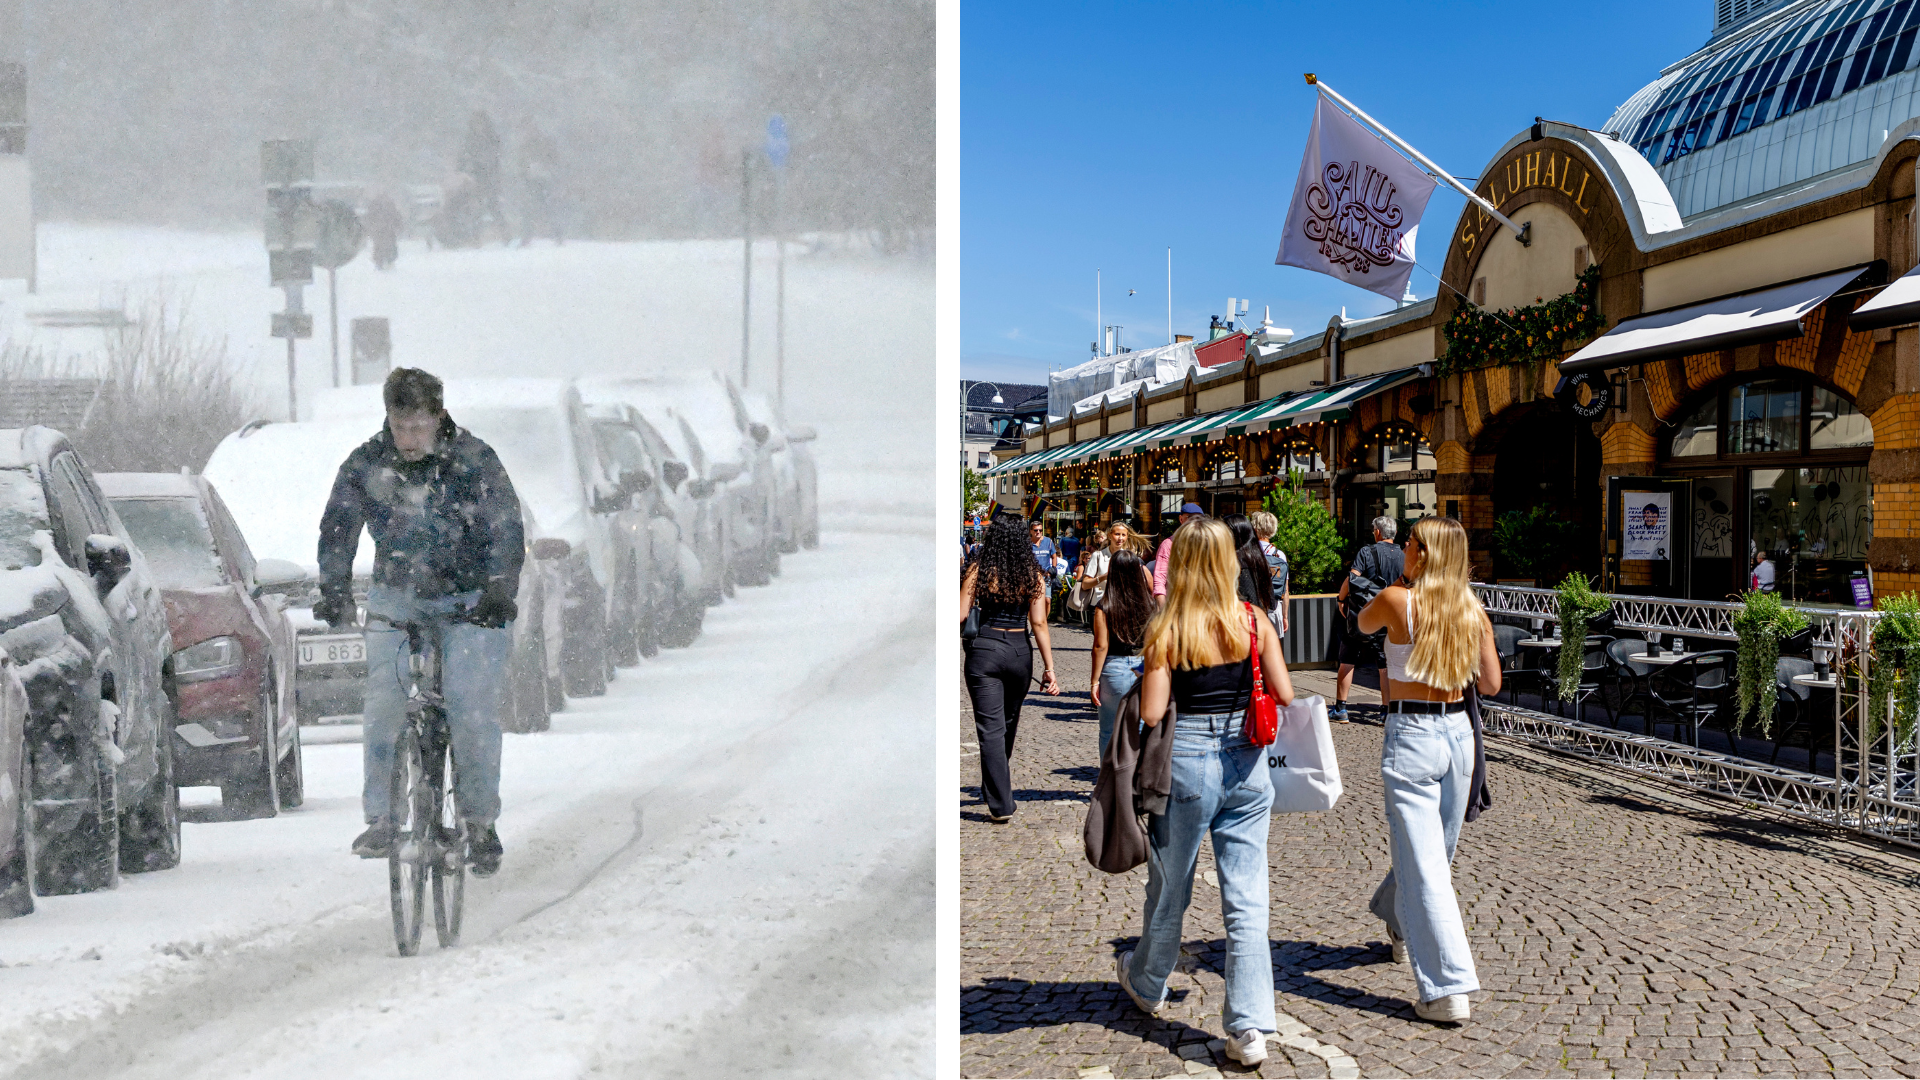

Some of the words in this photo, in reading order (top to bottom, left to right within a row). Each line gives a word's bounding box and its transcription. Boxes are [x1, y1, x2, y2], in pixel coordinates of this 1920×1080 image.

[1461, 151, 1590, 258] SALUHALL
[1571, 373, 1589, 385] WINE
[1572, 389, 1608, 417] MECHANICS
[328, 644, 364, 661] 863
[1268, 755, 1288, 768] OK
